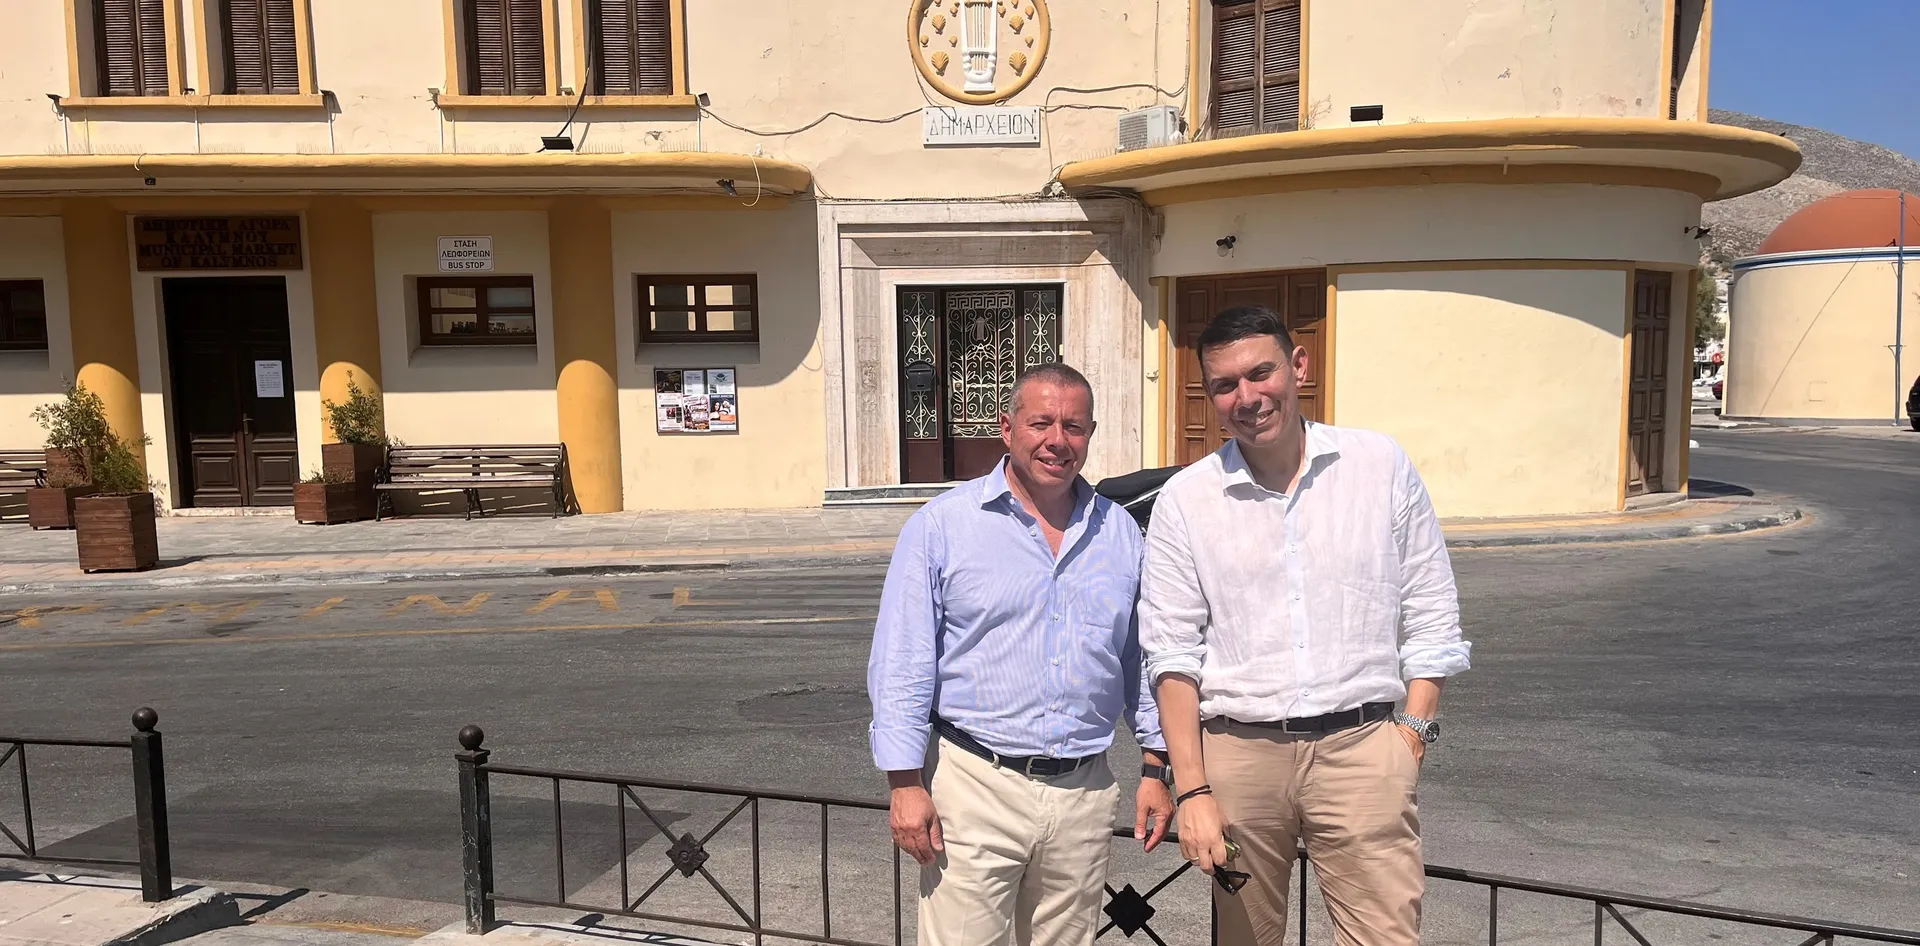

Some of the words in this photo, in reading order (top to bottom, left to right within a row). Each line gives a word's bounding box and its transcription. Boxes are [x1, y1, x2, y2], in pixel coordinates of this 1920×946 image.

[929, 114, 1035, 136] ΔΗΜΑΡΧΕΙΟΝ
[238, 218, 291, 230] ΑΓΟΡΑ
[165, 231, 268, 243] ΚΑΛΥΜΝΟΥ
[139, 244, 227, 256] MUNICIPAL
[232, 243, 298, 255] MARKET
[441, 250, 490, 258] ΛΕΩΦΟΡΕΙΩΝ
[161, 256, 182, 268] OF
[189, 256, 277, 268] KALYMNOS
[448, 261, 464, 269] BUS
[465, 261, 484, 269] STOP
